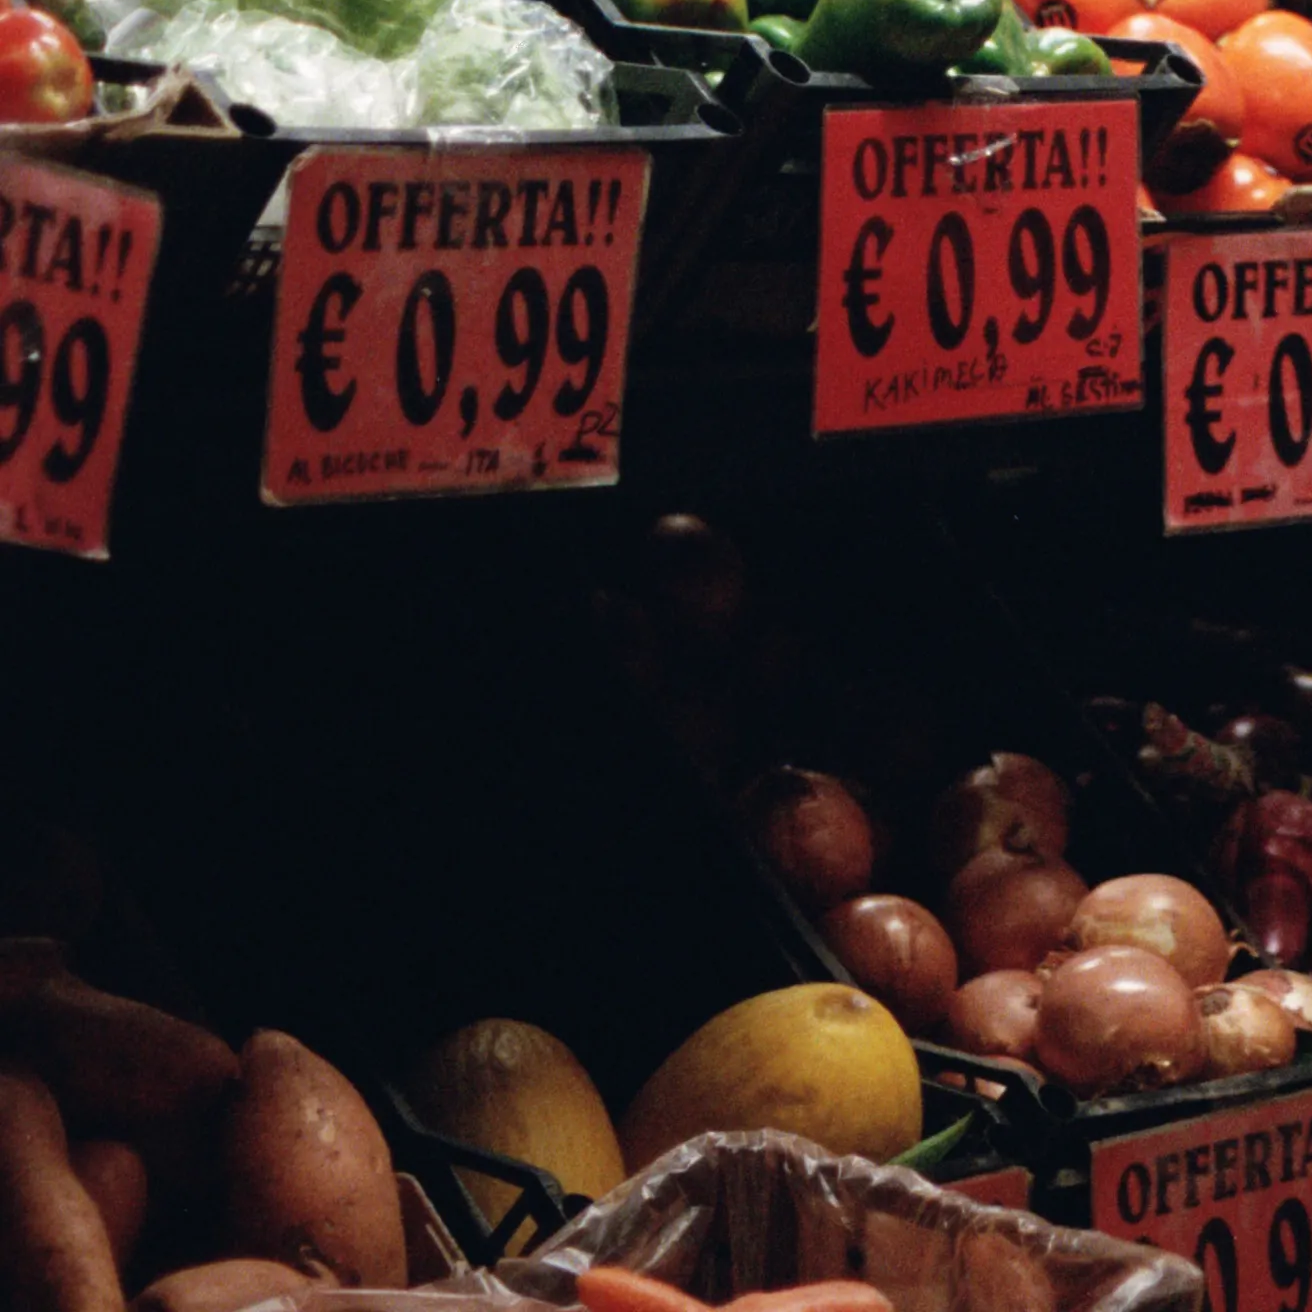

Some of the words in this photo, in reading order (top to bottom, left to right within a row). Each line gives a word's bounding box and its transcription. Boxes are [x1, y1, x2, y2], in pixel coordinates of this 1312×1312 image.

[317, 180, 622, 253] OFFERTA!!
[853, 128, 1108, 201] OFFERTA!!
[0, 198, 132, 303] TA!!
[842, 215, 895, 358] €
[926, 204, 1111, 359] 0,99
[295, 272, 362, 432] €
[396, 266, 609, 438] 0,99
[1185, 336, 1236, 474] €
